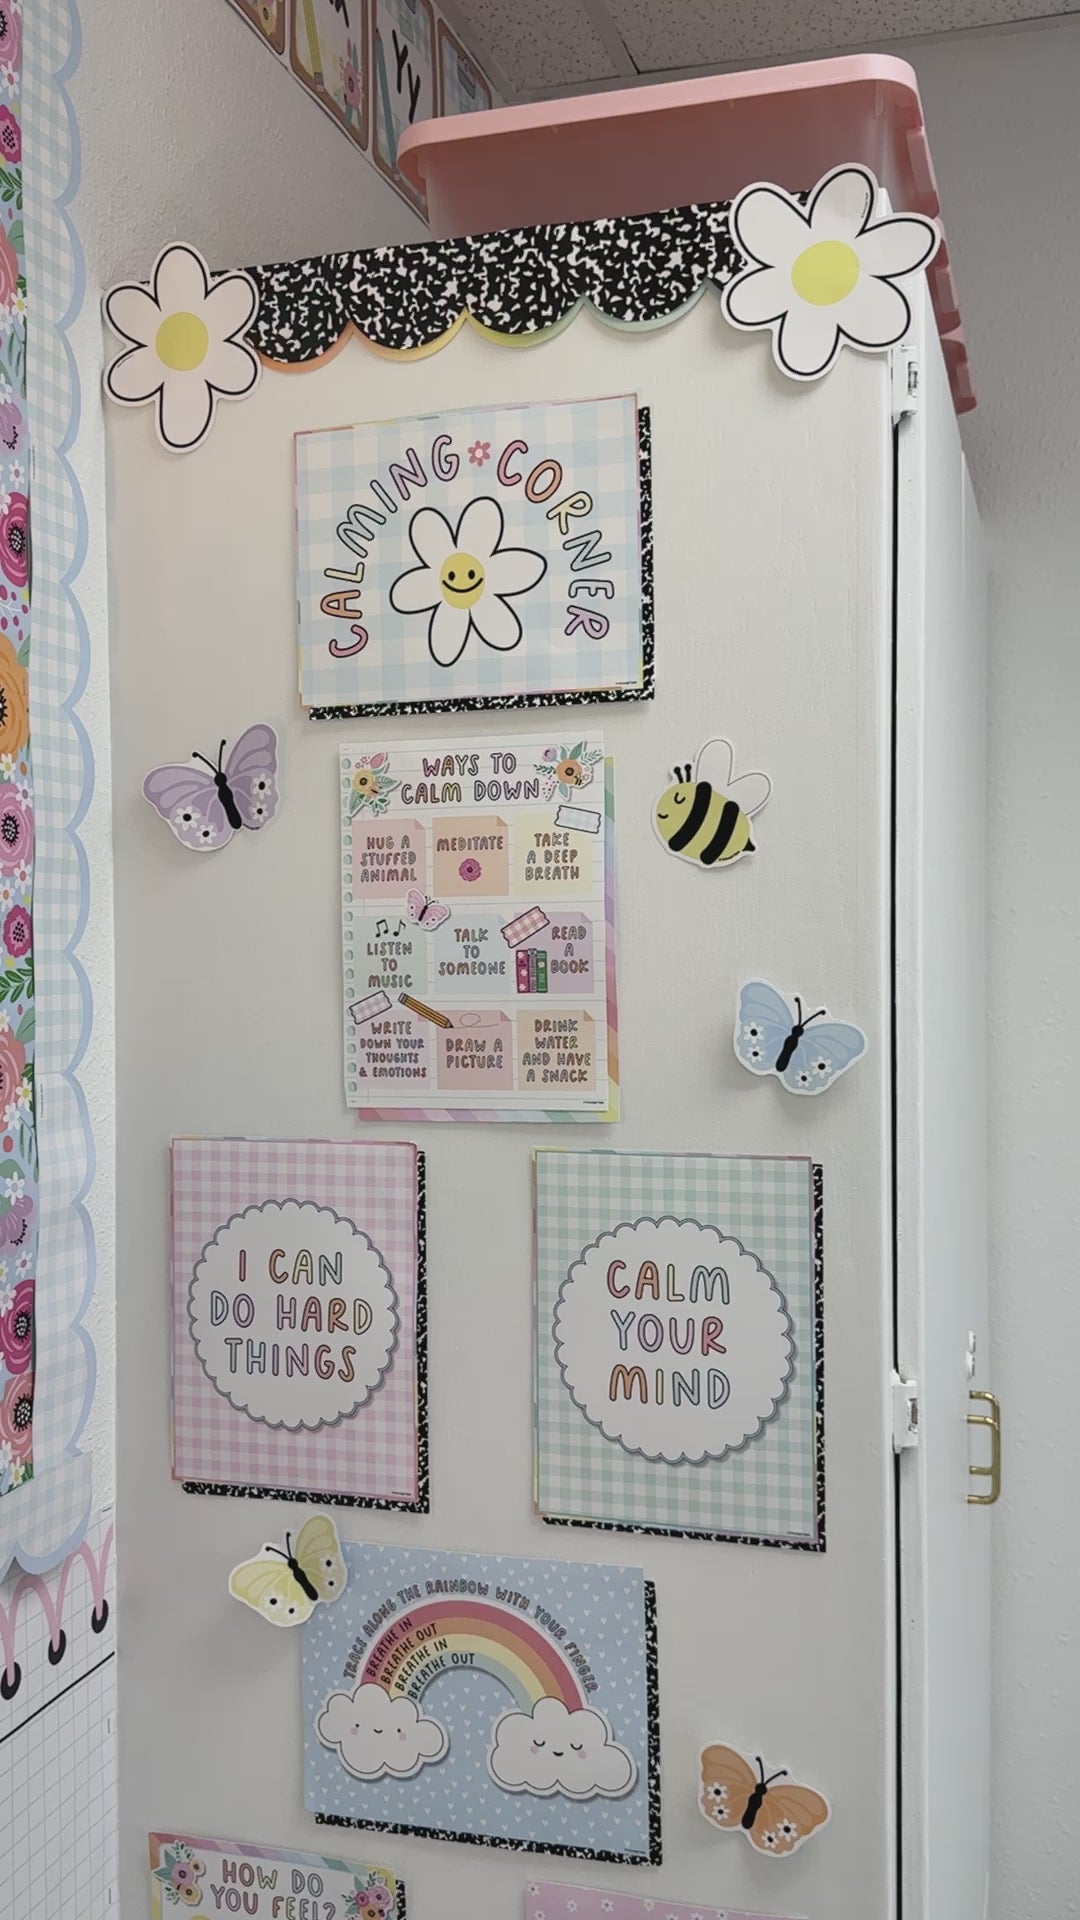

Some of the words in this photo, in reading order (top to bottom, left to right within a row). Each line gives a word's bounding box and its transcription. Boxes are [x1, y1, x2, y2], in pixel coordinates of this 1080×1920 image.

[320, 434, 461, 658] CALMING
[497, 440, 615, 640] CORNER
[422, 753, 480, 777] WAYS
[491, 752, 517, 774] TO
[401, 782, 462, 805] CALM
[474, 778, 539, 801] DOWN
[366, 835, 394, 850] HUG
[401, 835, 410, 849] A
[436, 835, 504, 851] MEDITATE
[534, 832, 570, 847] TAKE
[360, 851, 417, 866] STUFFED
[526, 850, 536, 863] A
[544, 849, 578, 863] DEEP
[360, 867, 417, 883] ANIMAL
[525, 866, 580, 881] BREATH
[454, 927, 489, 942] TALK
[551, 925, 586, 941] READ
[367, 941, 413, 956] LISTEN
[463, 944, 480, 959] TO
[564, 943, 574, 957] A
[381, 957, 398, 972] TO
[438, 960, 506, 976] SOMEONE
[550, 959, 589, 974] BOOK
[368, 974, 413, 989] MUSIC
[371, 1021, 412, 1035] WRITE
[534, 1018, 578, 1032] DRINK
[360, 1039, 391, 1049] DOWN
[397, 1037, 424, 1049] YOUR
[446, 1038, 487, 1052] DRAW
[493, 1038, 503, 1052] A
[535, 1035, 578, 1049] WATER
[366, 1052, 420, 1064] THOUGHTS
[446, 1055, 503, 1069] PICTURE
[522, 1052, 550, 1066] AND
[557, 1052, 591, 1066] HAVE
[359, 1068, 367, 1077] &
[372, 1067, 427, 1078] EMOTIONS
[526, 1069, 536, 1082] A
[542, 1068, 588, 1083] SNACK
[238, 1249, 247, 1282] I
[268, 1248, 343, 1286] CAN
[607, 1259, 730, 1305] CALM
[210, 1290, 255, 1328] DO
[276, 1294, 373, 1335] HARD
[610, 1309, 727, 1356] YOUR
[224, 1337, 357, 1382] THINGS
[609, 1364, 731, 1409] MIND
[343, 1637, 368, 1680] TRACE
[366, 1599, 397, 1637] ALONG
[397, 1583, 421, 1605] THE
[425, 1578, 489, 1596] RAINBOW
[496, 1587, 530, 1610] WITH
[535, 1606, 569, 1641] YOUR
[565, 1641, 600, 1694] FINGER
[367, 1630, 398, 1677] BREATHE
[399, 1617, 413, 1632] IN
[381, 1637, 414, 1685] BREATHE
[416, 1622, 438, 1641] OUT
[394, 1645, 431, 1691] BREATHE
[434, 1638, 449, 1652] IN
[408, 1655, 447, 1700] BREATHE
[451, 1653, 475, 1665] OUT
[222, 1858, 278, 1890] HOW
[291, 1868, 324, 1898] DO
[210, 1883, 259, 1916] YOU
